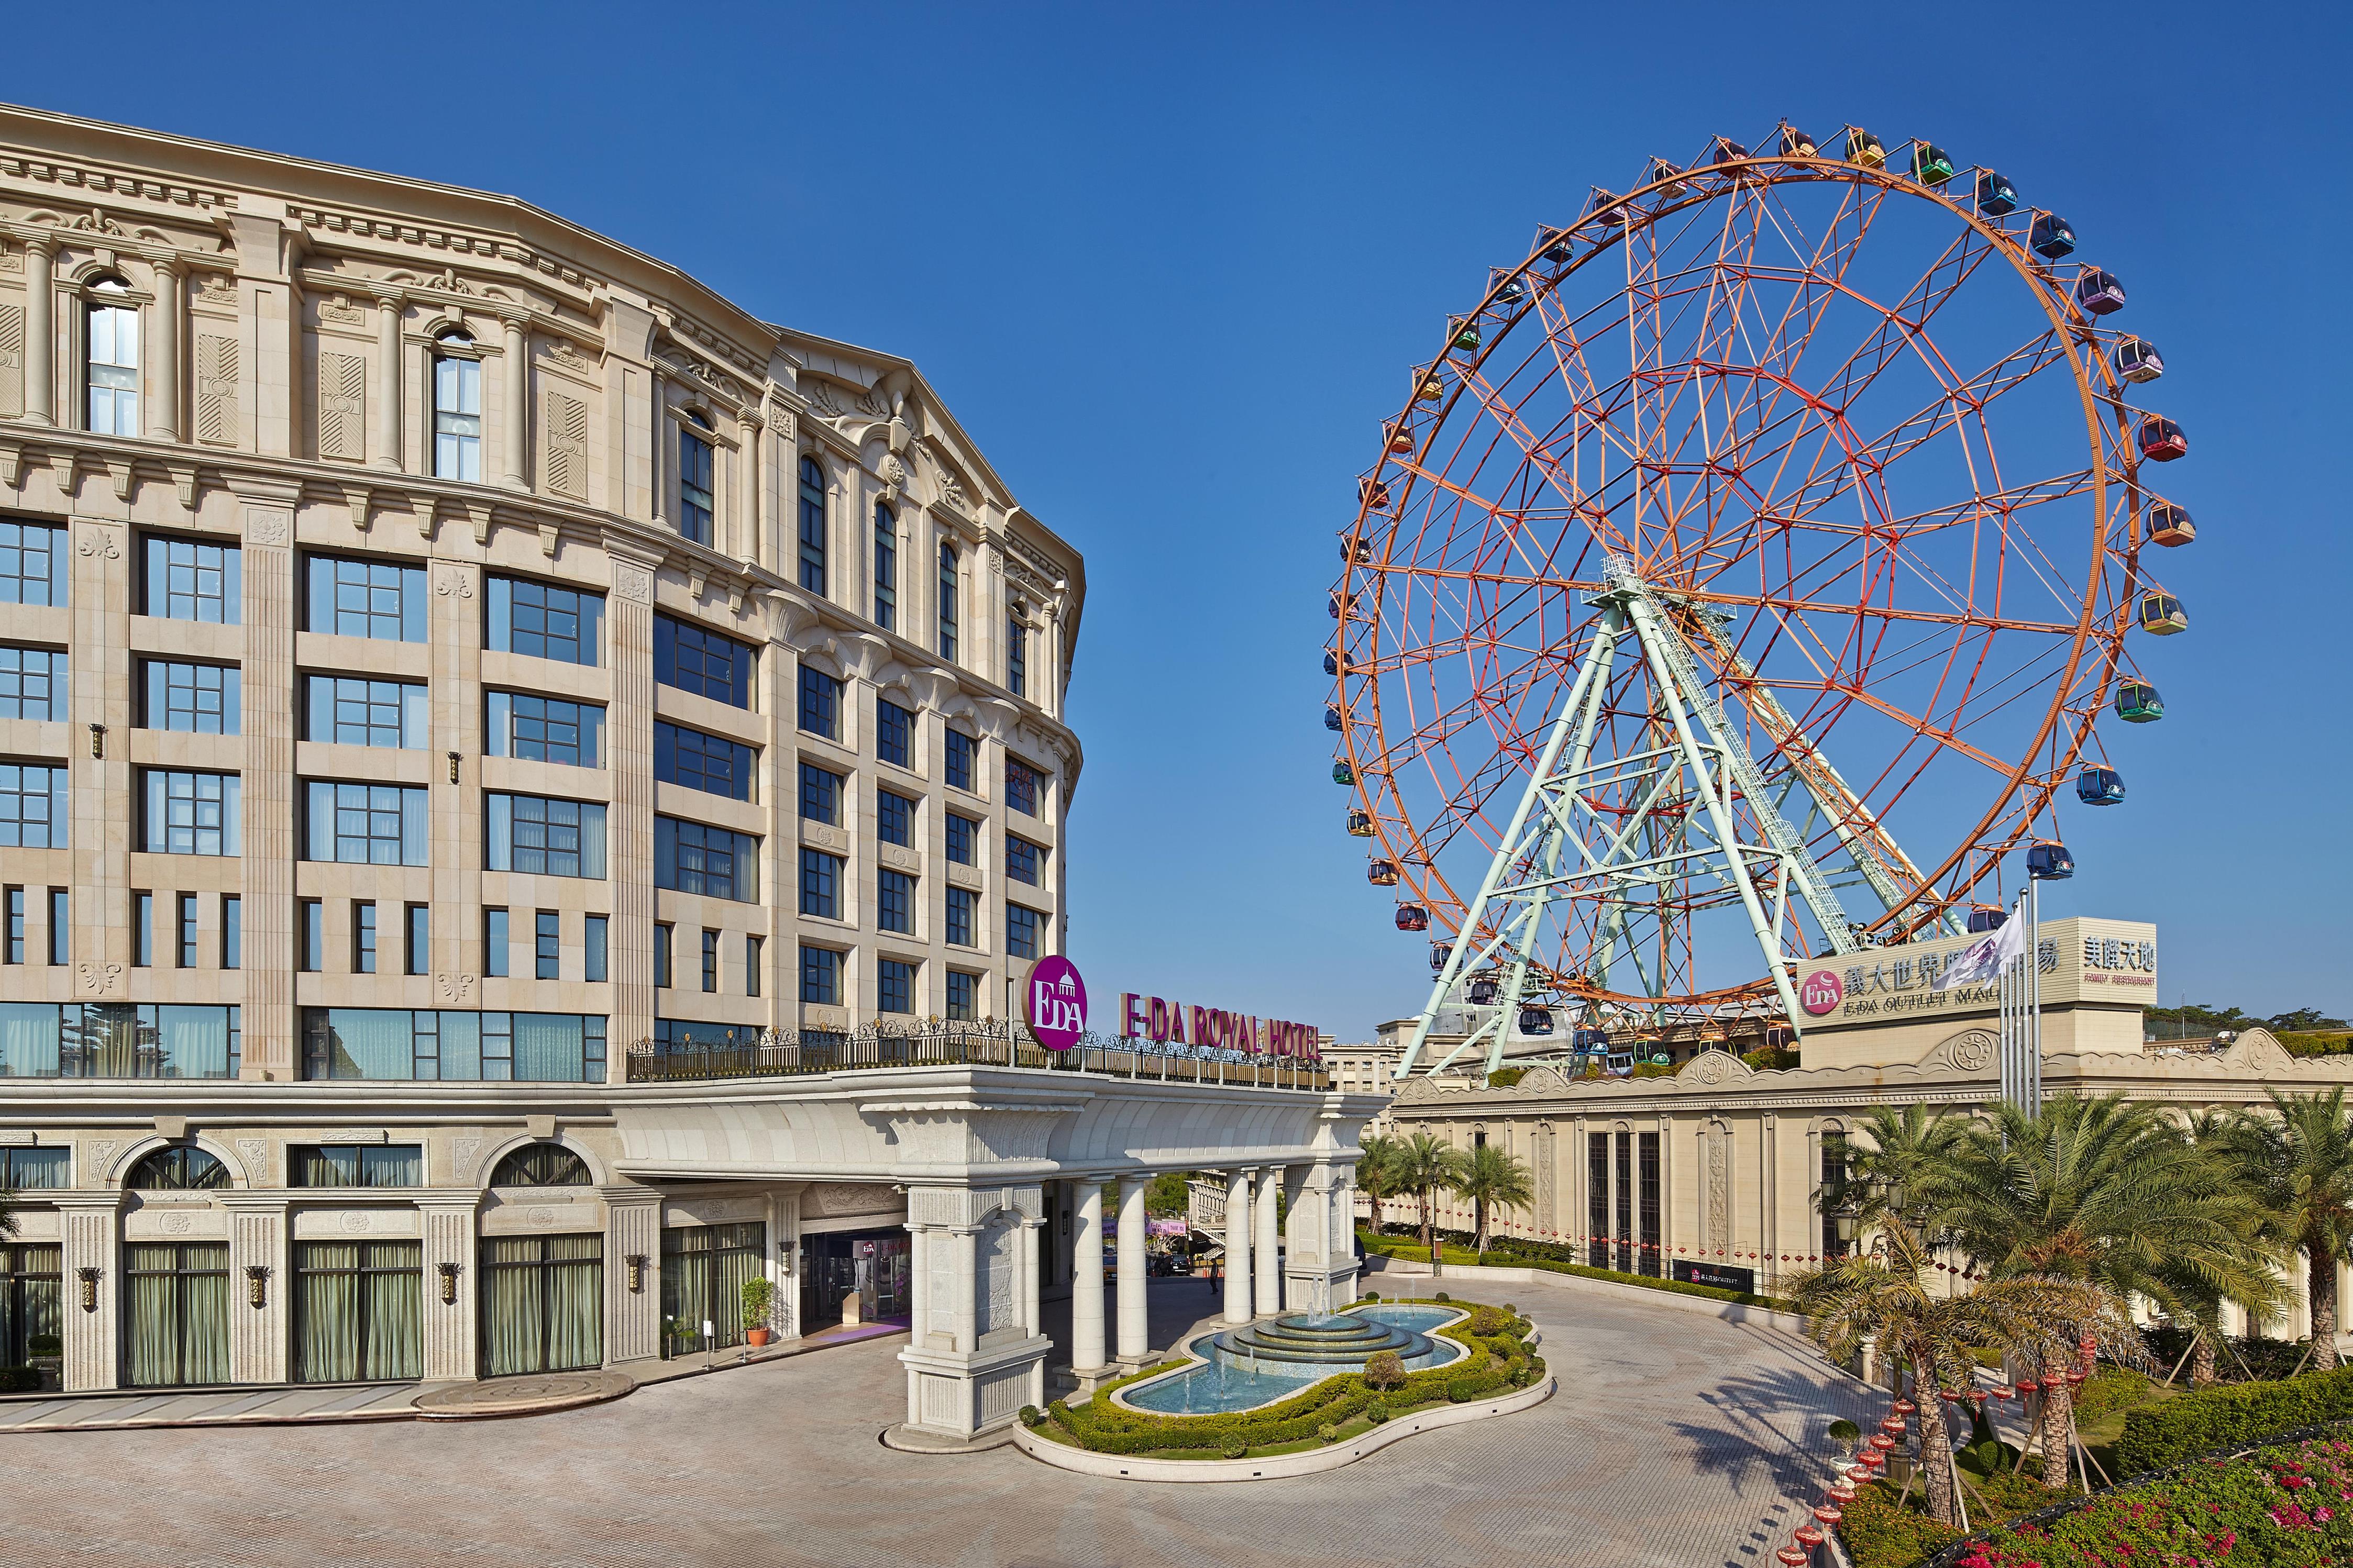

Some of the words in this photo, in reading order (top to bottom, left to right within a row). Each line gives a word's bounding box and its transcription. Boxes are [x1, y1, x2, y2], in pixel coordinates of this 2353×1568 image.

[2085, 936, 2155, 971] 美饌天地
[2086, 973, 2109, 982] FAMILY
[2114, 975, 2156, 985] RESTAURANT
[1033, 980, 1084, 1033] EDA
[1886, 991, 1949, 1008] OUTLET
[1121, 993, 1185, 1043] E-DA
[1189, 1005, 1262, 1053] ROYAL
[1265, 1019, 1322, 1060] HOTEL
